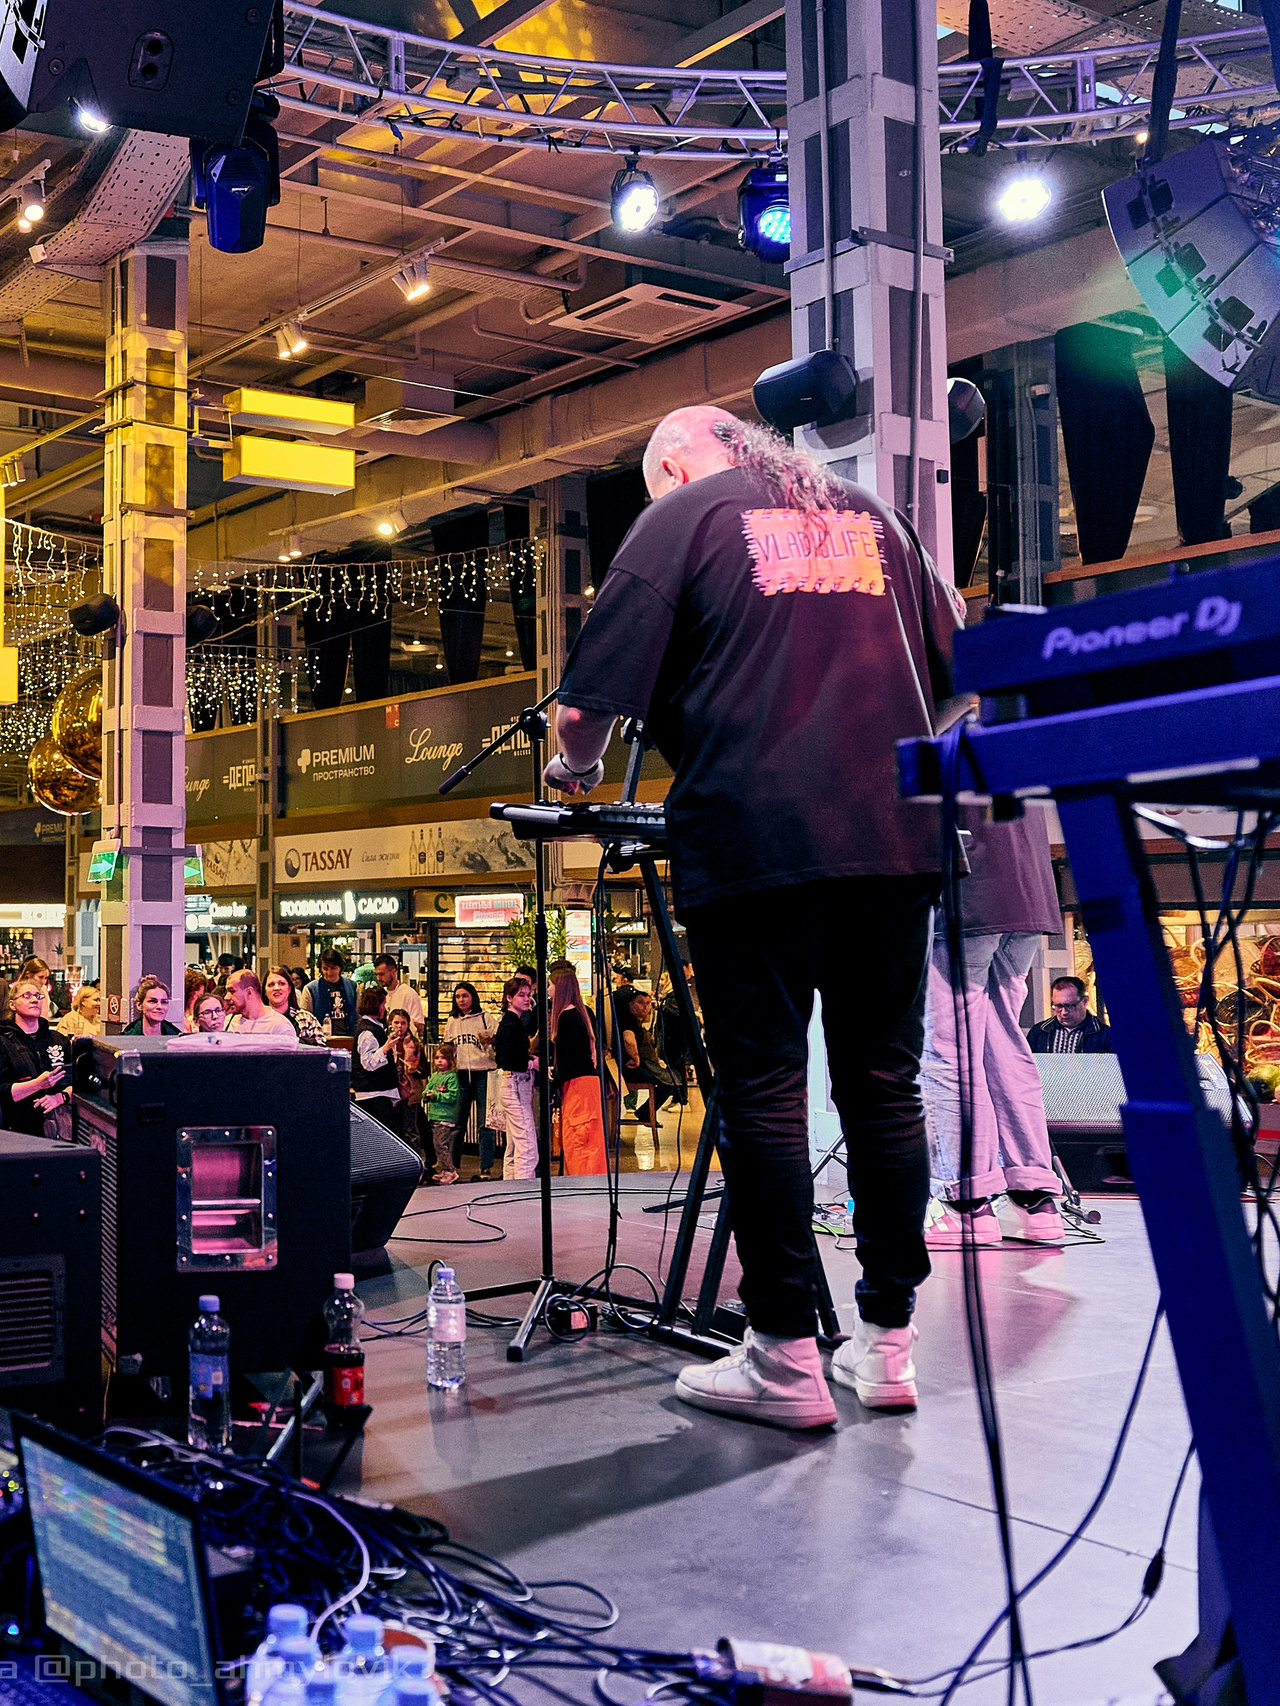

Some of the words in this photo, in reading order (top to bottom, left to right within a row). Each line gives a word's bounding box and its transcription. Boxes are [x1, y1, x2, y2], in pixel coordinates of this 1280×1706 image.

[1041, 610, 1189, 660] Pioneer
[312, 743, 375, 767] PREMIUM
[405, 728, 464, 771] Lounge
[312, 765, 375, 782] ПРОСТРАНСТВО
[302, 848, 353, 872] TASSAY
